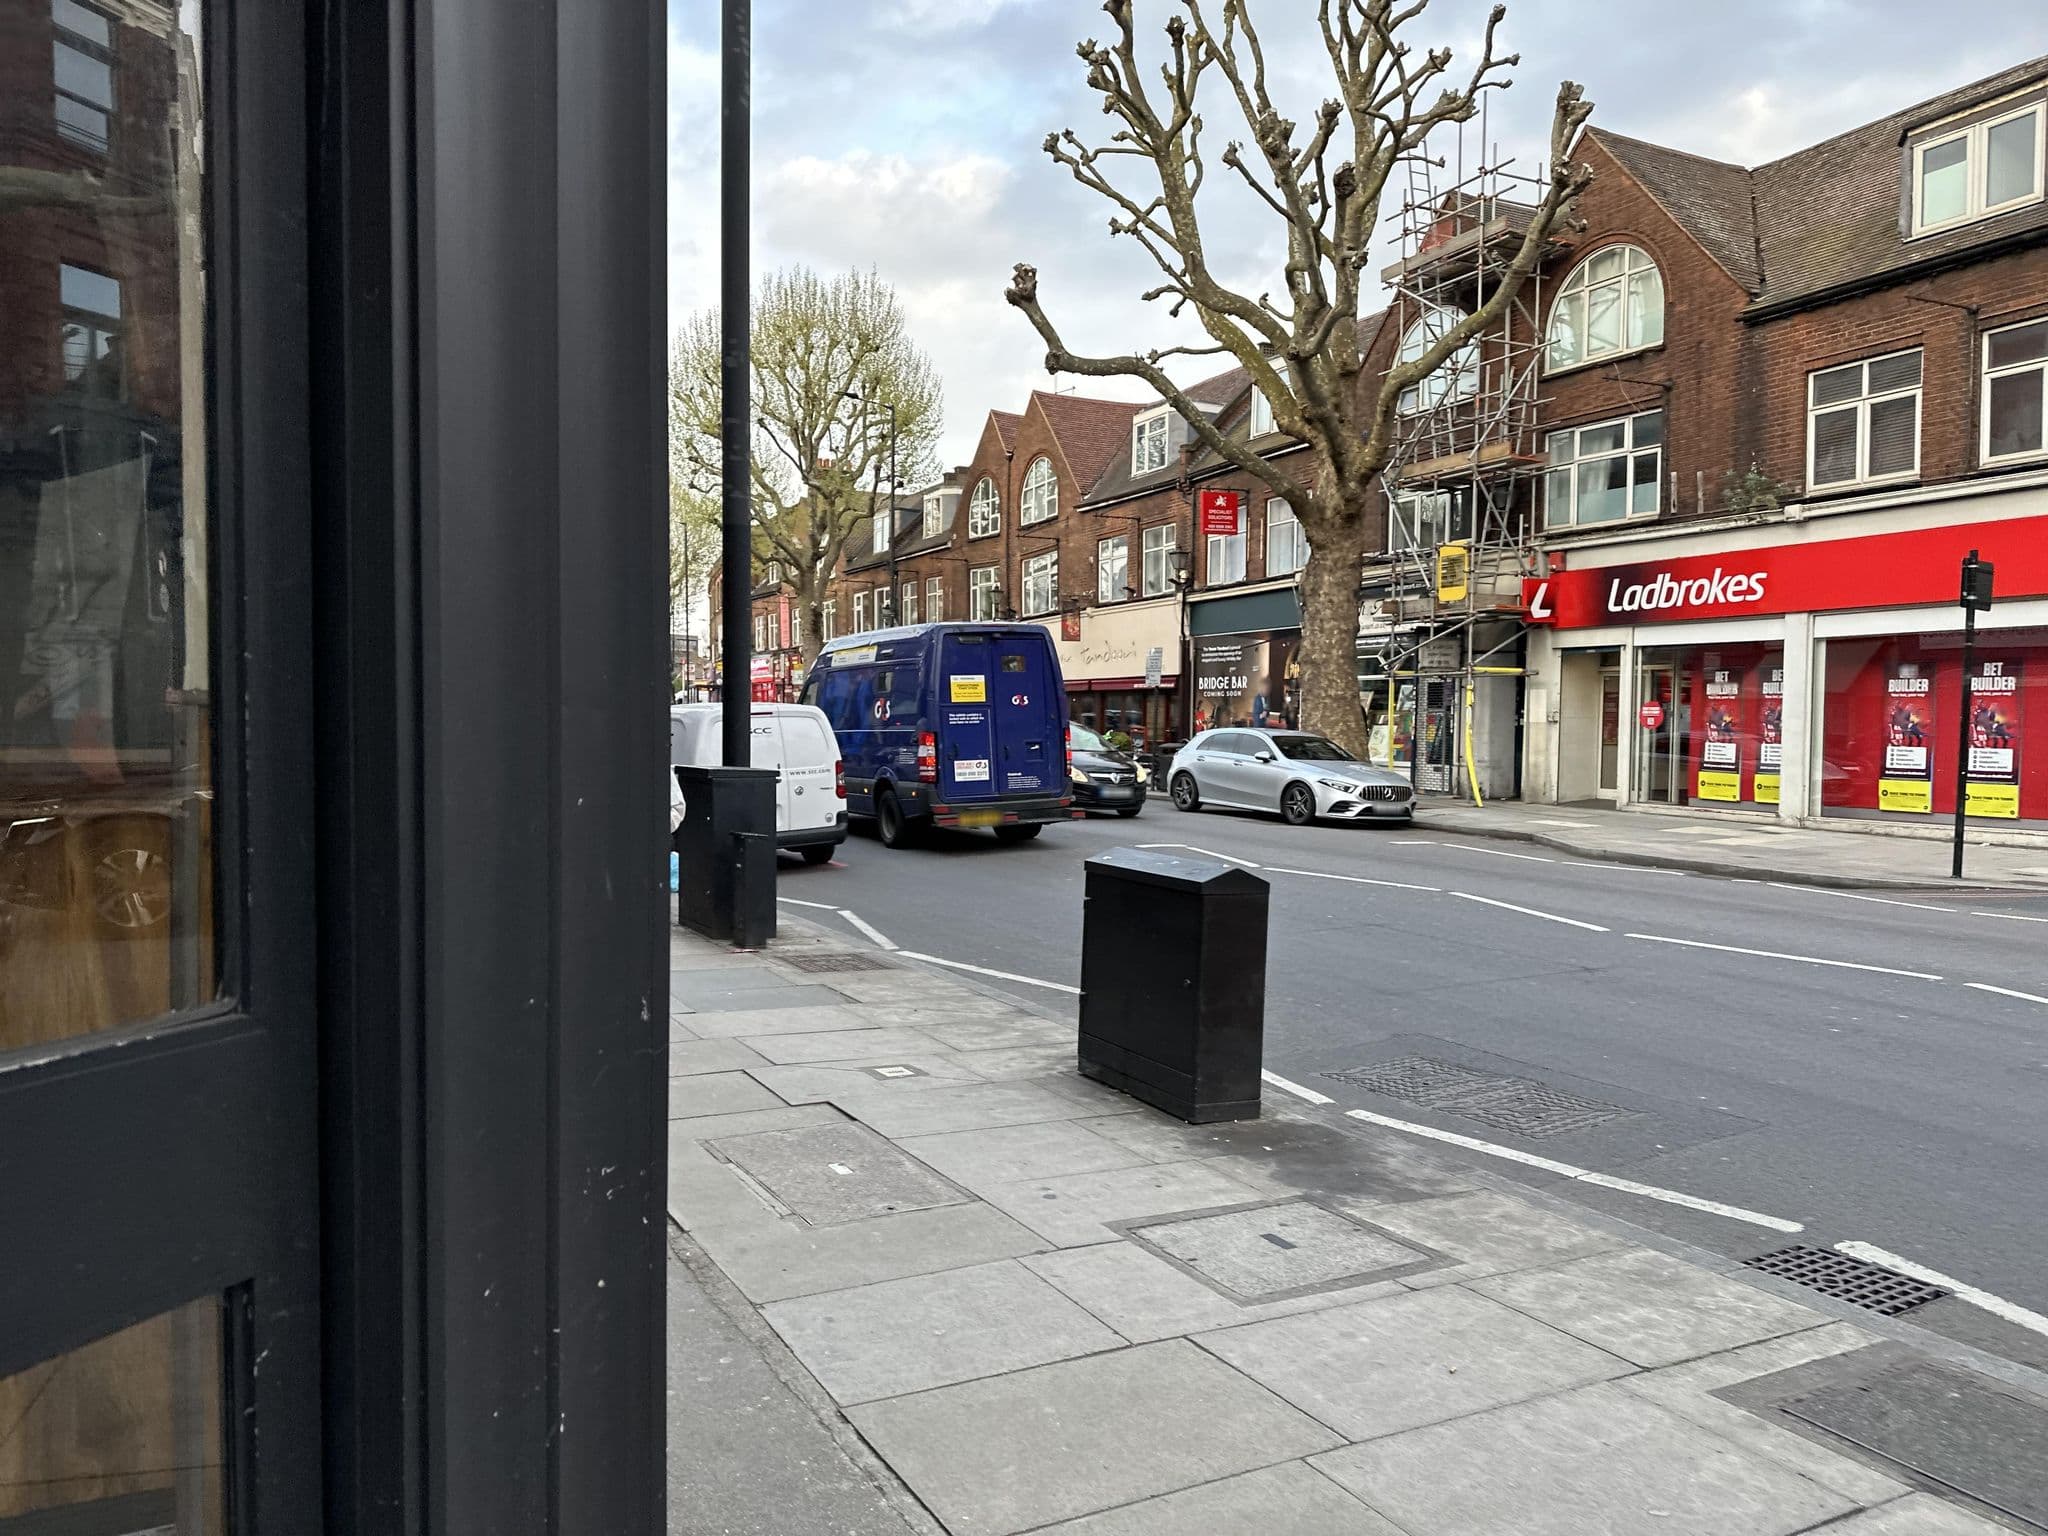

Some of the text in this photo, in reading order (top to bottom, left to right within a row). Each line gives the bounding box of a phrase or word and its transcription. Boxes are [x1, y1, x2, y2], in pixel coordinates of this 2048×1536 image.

[1607, 567, 1768, 613] Ladbrokes
[1715, 670, 1729, 682] BET
[1772, 669, 1784, 682] BE
[1983, 662, 2003, 676] BET
[1198, 675, 1248, 690] BRIDGE BAR
[1888, 678, 1929, 693] BUILDER
[1971, 676, 2016, 691] BUILDER
